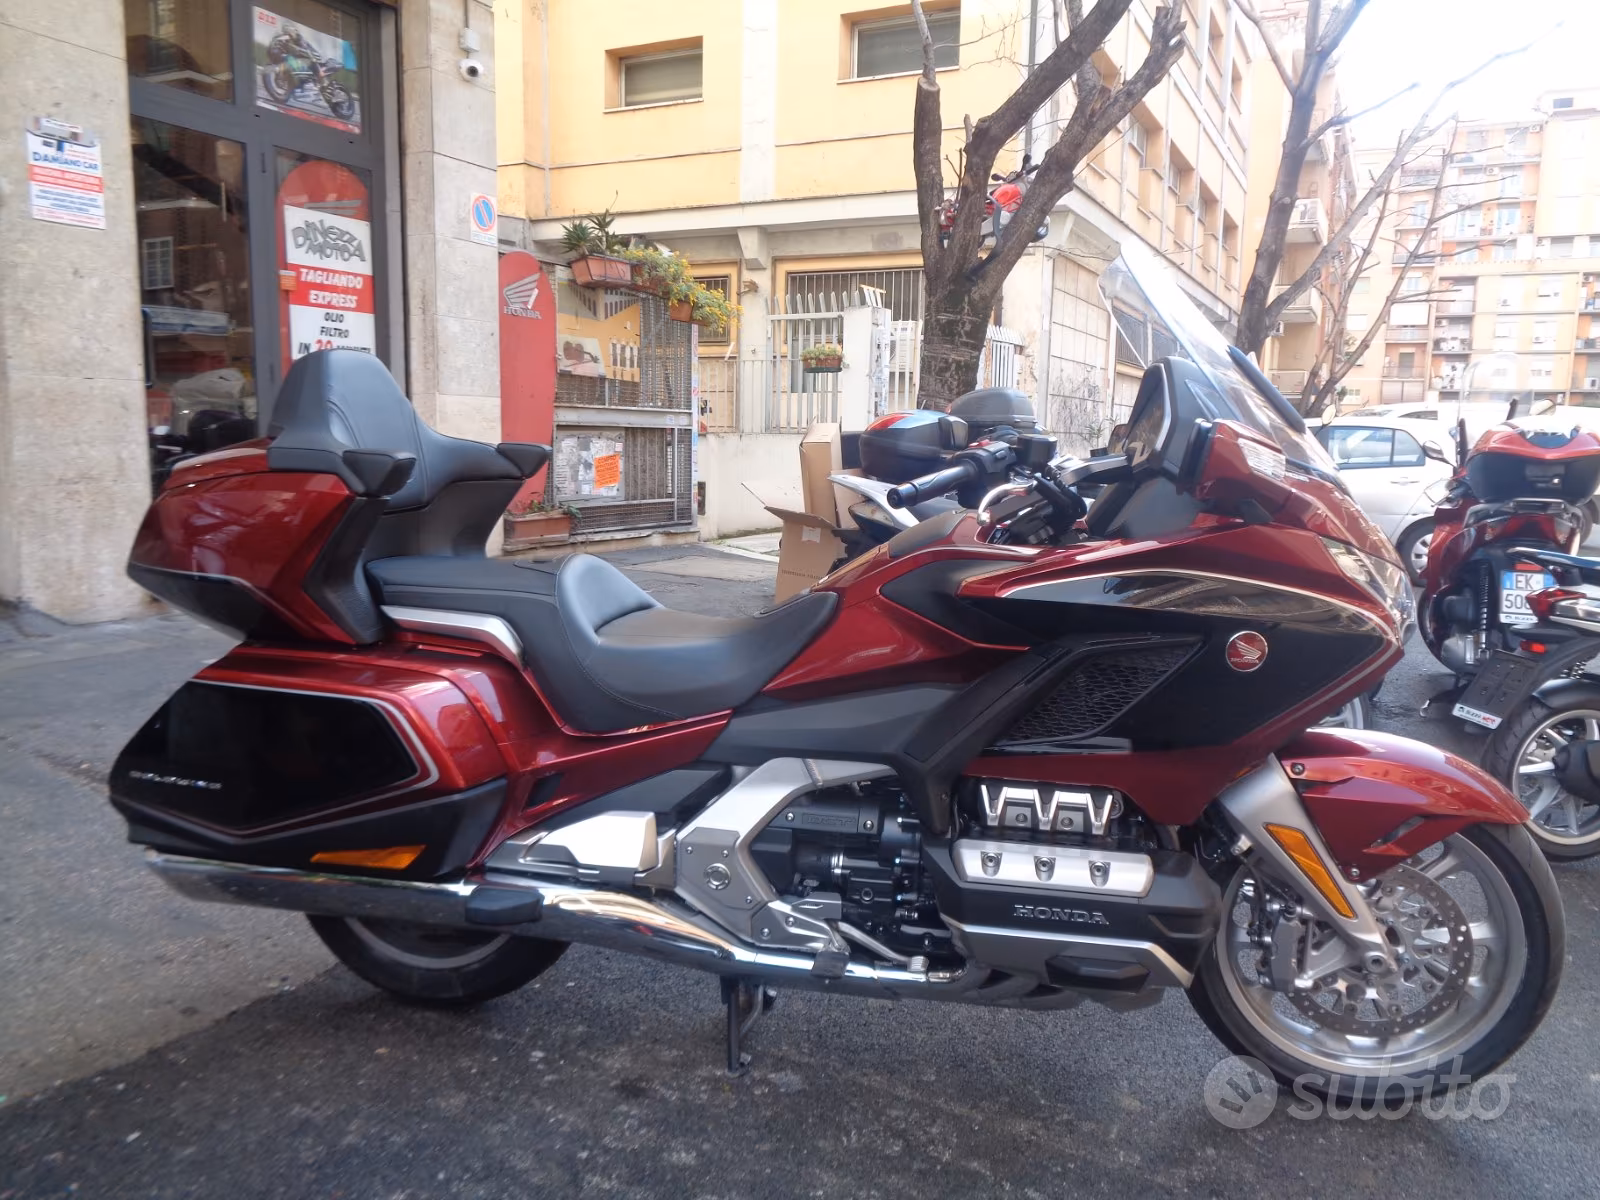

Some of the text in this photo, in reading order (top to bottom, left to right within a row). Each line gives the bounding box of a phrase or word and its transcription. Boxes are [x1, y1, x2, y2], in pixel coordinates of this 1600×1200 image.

[299, 268, 363, 289] TAGLIANDO
[308, 290, 358, 308] EXPRESS
[324, 312, 344, 323] OLIO
[503, 305, 542, 319] HONDA
[320, 326, 349, 338] FILTRO
[298, 342, 311, 354] IN
[1515, 574, 1534, 591] EK
[1013, 904, 1110, 925] HONDA
